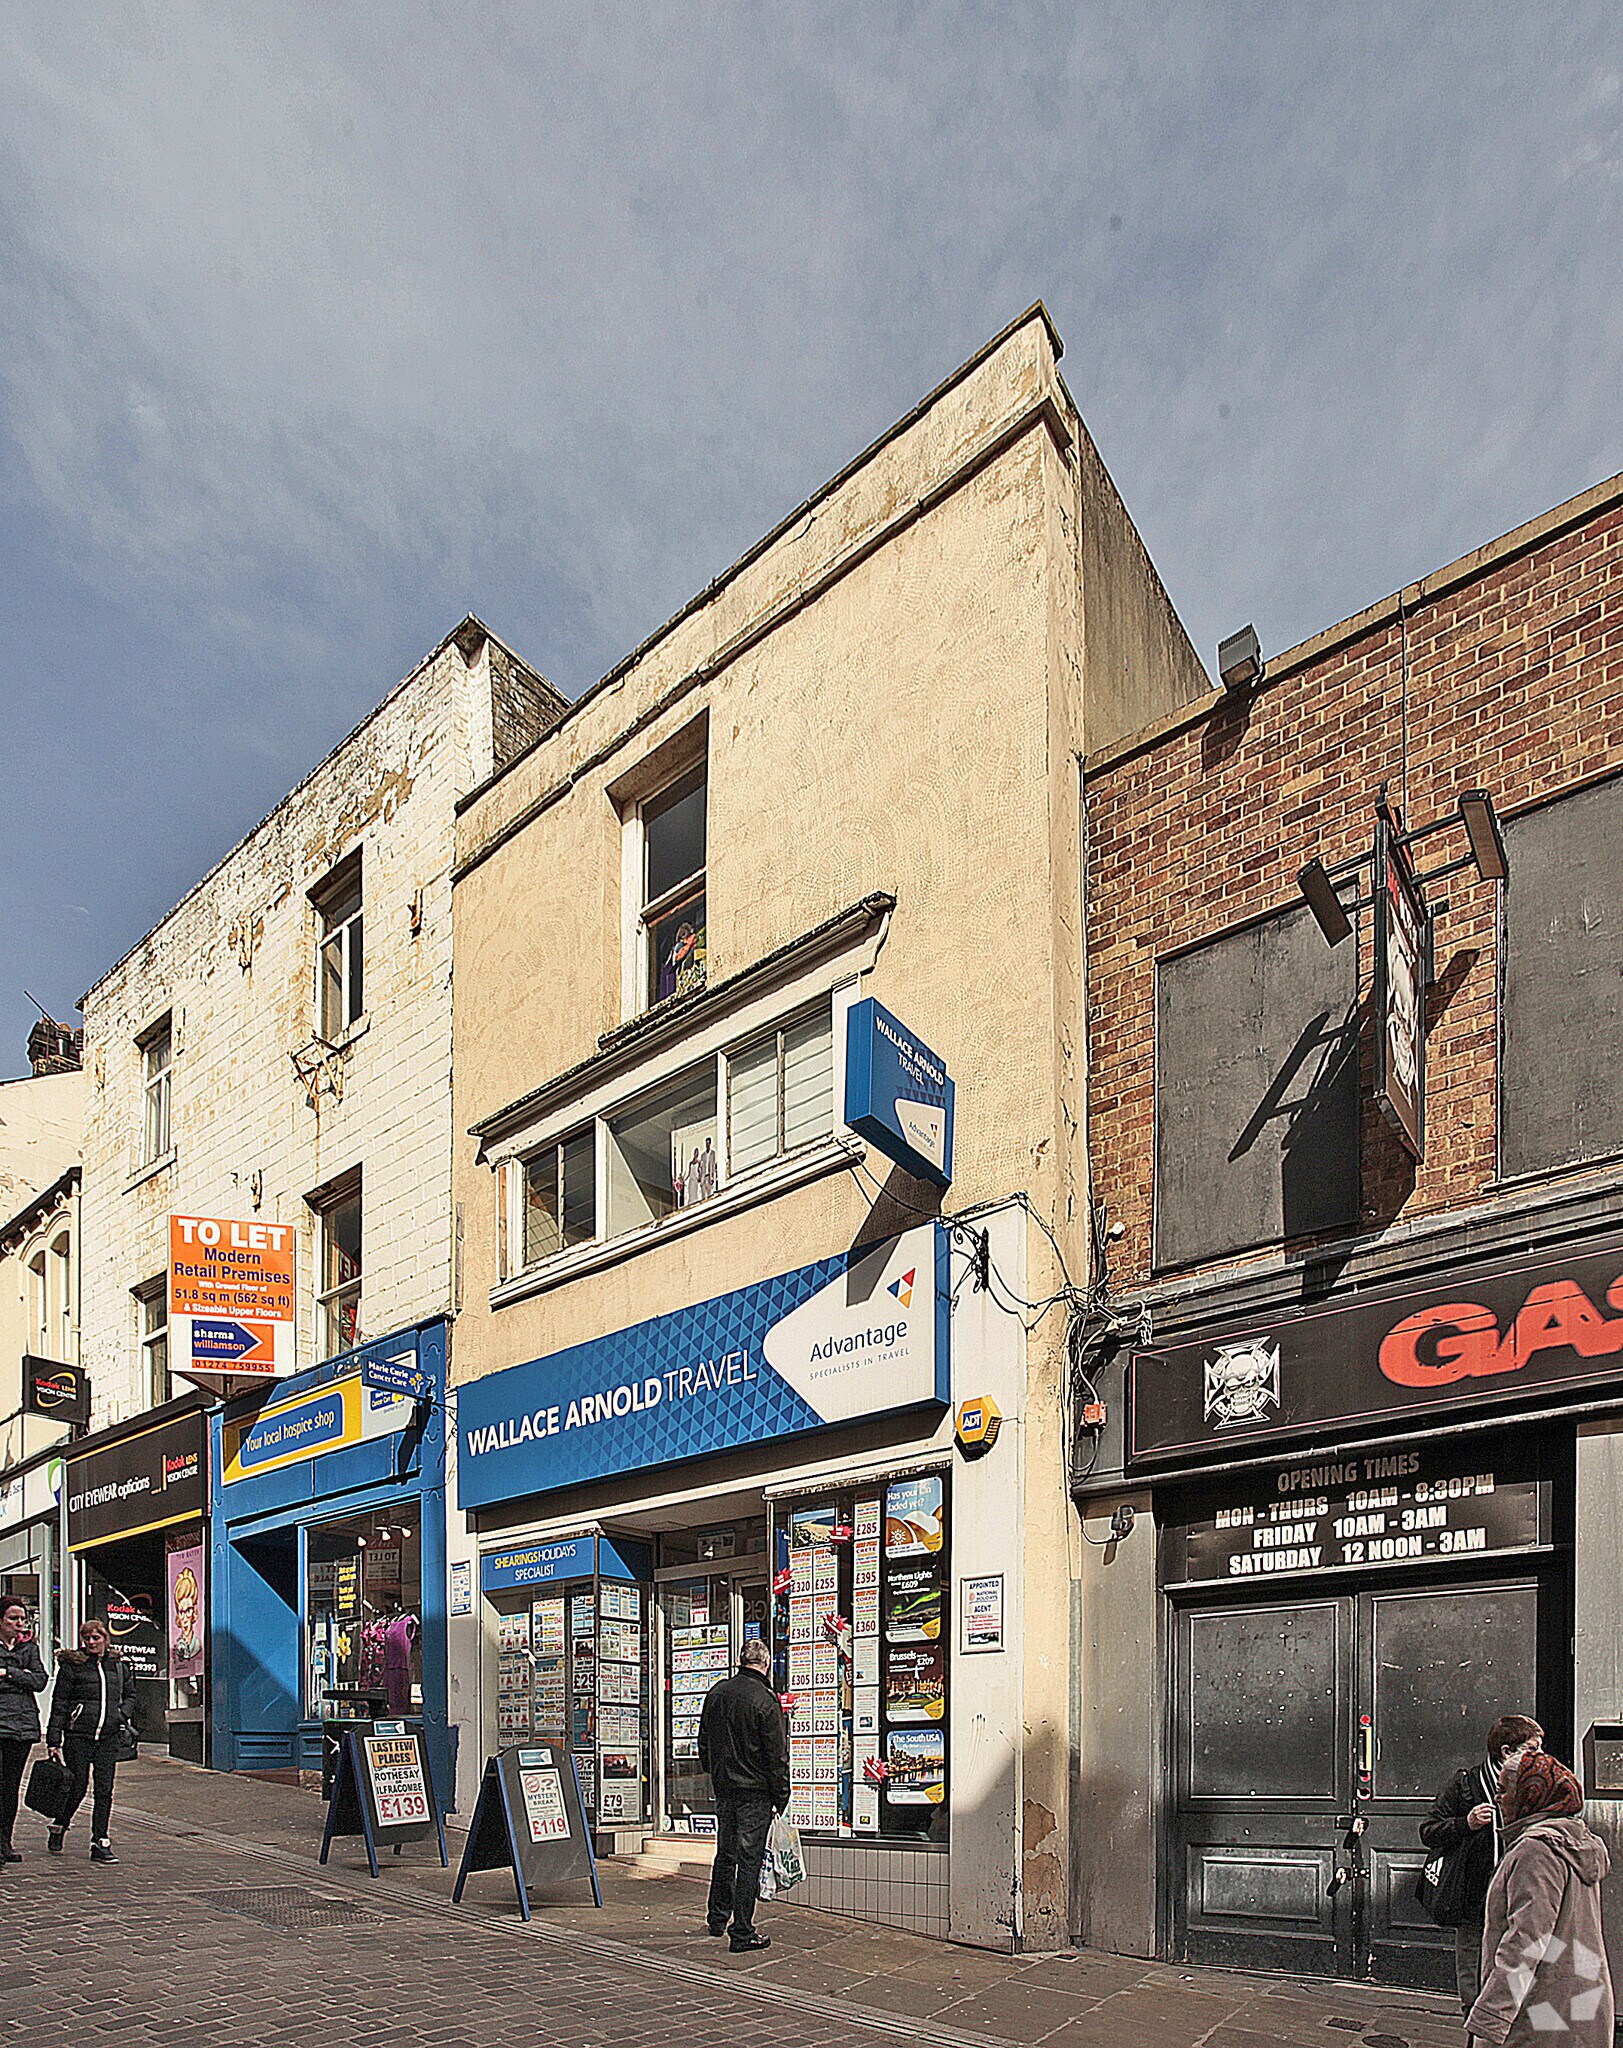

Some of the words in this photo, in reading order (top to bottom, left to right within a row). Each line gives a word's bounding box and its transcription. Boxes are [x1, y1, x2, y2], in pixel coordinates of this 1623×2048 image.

[876, 1016, 913, 1059] WALLACE
[913, 1052, 943, 1085] ARNOLD
[898, 1052, 924, 1085] TRAVEL
[178, 1218, 220, 1246] TO
[231, 1222, 286, 1251] LET
[205, 1248, 261, 1264] Modern
[175, 1262, 216, 1278] Retail
[222, 1266, 290, 1284] Premises
[215, 1282, 240, 1291] Ground
[241, 1284, 258, 1292] Floor
[175, 1289, 198, 1299] 51.8
[202, 1291, 215, 1302] sq
[220, 1293, 229, 1302] m
[234, 1292, 257, 1304] (562
[261, 1296, 274, 1306] sq
[278, 1296, 290, 1308] ft)
[184, 1303, 191, 1312] &
[192, 1304, 227, 1314] Sizeable
[229, 1306, 254, 1317] Upper
[256, 1307, 282, 1318] Floors
[194, 1329, 234, 1340] sharma
[194, 1339, 246, 1351] williamson
[810, 1322, 907, 1362] Advantage
[196, 1360, 227, 1369] 01274
[232, 1363, 271, 1371] 759955
[368, 1361, 389, 1375] Marie
[389, 1366, 409, 1379] Curie
[810, 1360, 860, 1380] SPECIALISTS
[878, 1348, 909, 1362] TRAVEL
[368, 1370, 392, 1383] Cancer
[392, 1376, 408, 1387] Care
[36, 1378, 60, 1390] Kodak
[61, 1385, 76, 1394] LENS
[36, 1386, 55, 1395] VISION
[467, 1406, 560, 1456] WALLACE
[564, 1377, 663, 1431] ARNOLD
[663, 1349, 757, 1401] TRAVEL
[963, 1413, 981, 1428] ADT
[246, 1434, 262, 1452] Your
[264, 1426, 282, 1446] local
[283, 1418, 313, 1439] hospice
[314, 1411, 335, 1429] shop
[167, 1455, 185, 1471] Kodak
[186, 1453, 198, 1465] LENS
[1278, 1462, 1357, 1492] OPENING
[1363, 1452, 1420, 1479] TIMES
[69, 1492, 85, 1512] CITY
[85, 1482, 118, 1508] EYEWEAR
[118, 1476, 150, 1500] opticians
[888, 1492, 900, 1500] Has
[902, 1490, 918, 1499] your
[888, 1502, 908, 1512] faded
[909, 1498, 924, 1510] yet?
[1215, 1506, 1254, 1529] MON
[1269, 1496, 1329, 1522] THURS
[1346, 1486, 1398, 1511] 10AM
[1415, 1473, 1495, 1502] 8:30PM
[856, 1522, 876, 1535] £285
[1253, 1522, 1317, 1548] FRIDAY
[1333, 1513, 1385, 1539] 10AM
[1401, 1505, 1447, 1530] 3AM
[495, 1551, 538, 1569] SHEARINGS
[538, 1544, 576, 1562] HOLIDAYS
[1229, 1546, 1322, 1575] SATURDAY
[1342, 1542, 1364, 1563] 12
[1368, 1535, 1422, 1560] NOON
[1439, 1527, 1486, 1553] 3AM
[515, 1564, 554, 1581] SPECIALIST
[856, 1571, 876, 1584] £395
[888, 1574, 913, 1582] Northern
[914, 1571, 932, 1580] Lights
[791, 1580, 810, 1593] £320
[815, 1577, 834, 1590] £255
[902, 1581, 918, 1589] £609
[969, 1580, 999, 1590] APPOINTED
[107, 1604, 135, 1613] Kodak
[974, 1604, 991, 1613] AGENT
[856, 1620, 876, 1632] £360
[792, 1628, 810, 1639] £345
[124, 1645, 156, 1654] EYEWEAR
[889, 1651, 916, 1661] Brussels
[917, 1656, 934, 1665] £209
[574, 1673, 594, 1689] £29
[791, 1674, 810, 1685] £305
[815, 1673, 834, 1684] £359
[792, 1721, 810, 1732] £355
[815, 1720, 834, 1731] £225
[893, 1735, 906, 1743] The
[907, 1734, 925, 1742] South
[927, 1734, 940, 1742] USA
[372, 1741, 394, 1753] LAST
[395, 1741, 412, 1751] FEW
[378, 1752, 410, 1764] PLACES
[374, 1769, 419, 1781] ROTHESAY
[792, 1768, 810, 1779] £455
[815, 1768, 834, 1779] £375
[376, 1782, 422, 1794] ILFRACOMBE
[381, 1796, 425, 1818] £139
[604, 1794, 622, 1807] £79
[792, 1814, 810, 1825] £295
[815, 1815, 834, 1826] £350
[533, 1818, 566, 1835] £119
